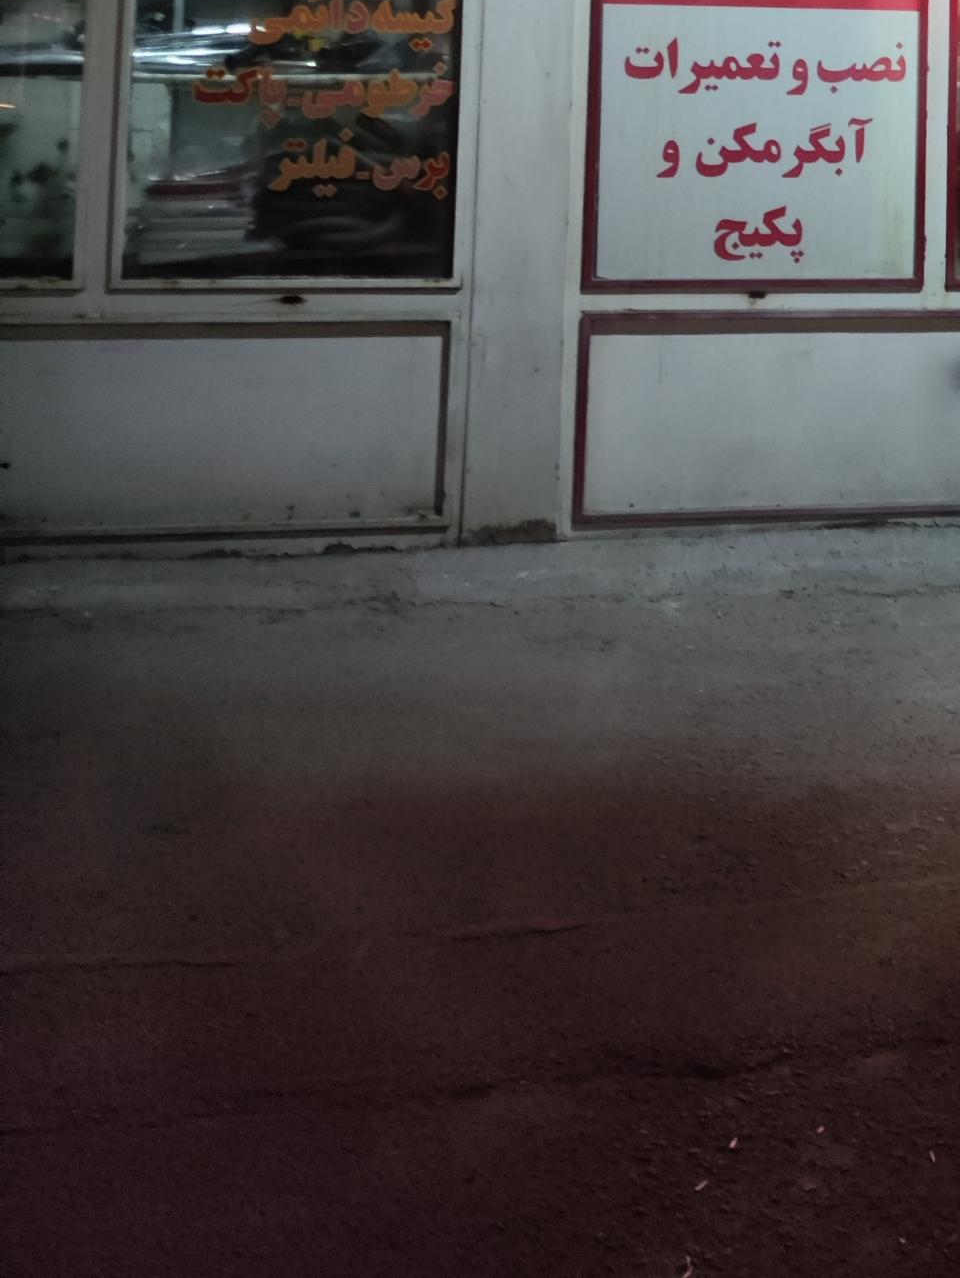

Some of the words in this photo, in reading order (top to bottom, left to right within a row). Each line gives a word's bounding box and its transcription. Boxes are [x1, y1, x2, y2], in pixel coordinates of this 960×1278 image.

[623, 37, 782, 96] تعمیرات
[786, 56, 810, 96] و
[816, 40, 907, 93] نصب
[267, 127, 357, 199] فیلتر
[656, 138, 681, 179] و
[695, 117, 873, 179] آبگرمکن
[713, 205, 804, 265] پکیج
